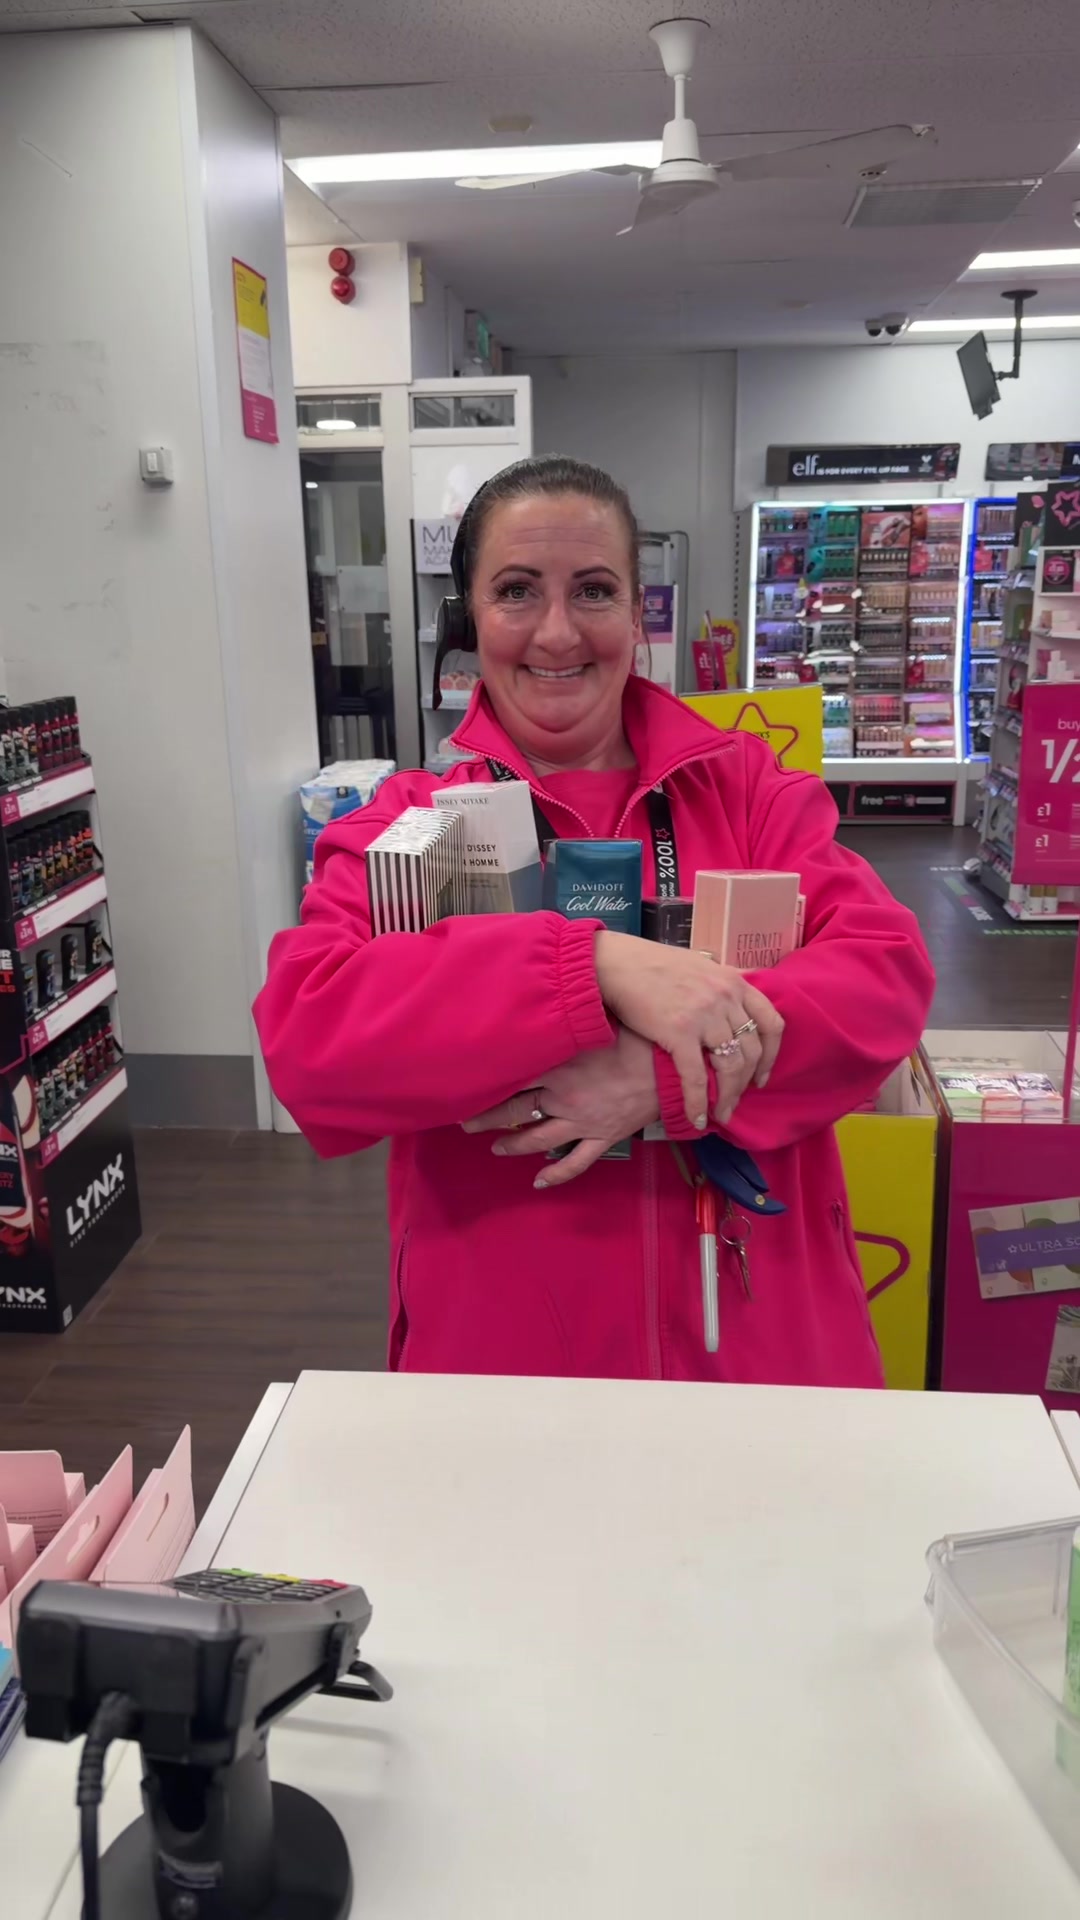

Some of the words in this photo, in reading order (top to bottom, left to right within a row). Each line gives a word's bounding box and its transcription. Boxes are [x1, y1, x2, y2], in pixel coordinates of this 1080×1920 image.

[793, 455, 819, 476] elf
[461, 798, 489, 806] MIYAKE
[1037, 803, 1051, 817] £1
[1035, 834, 1049, 848] £1
[469, 858, 500, 867] HOMME
[656, 839, 675, 879] 100%
[572, 883, 624, 892] DAVIDOFF
[566, 895, 595, 912] Cool
[593, 895, 632, 912] Water
[736, 932, 783, 951] ETERNITY
[736, 948, 782, 969] MOMENT
[66, 1153, 125, 1236] LYNX
[1018, 1238, 1062, 1253] ULTRA
